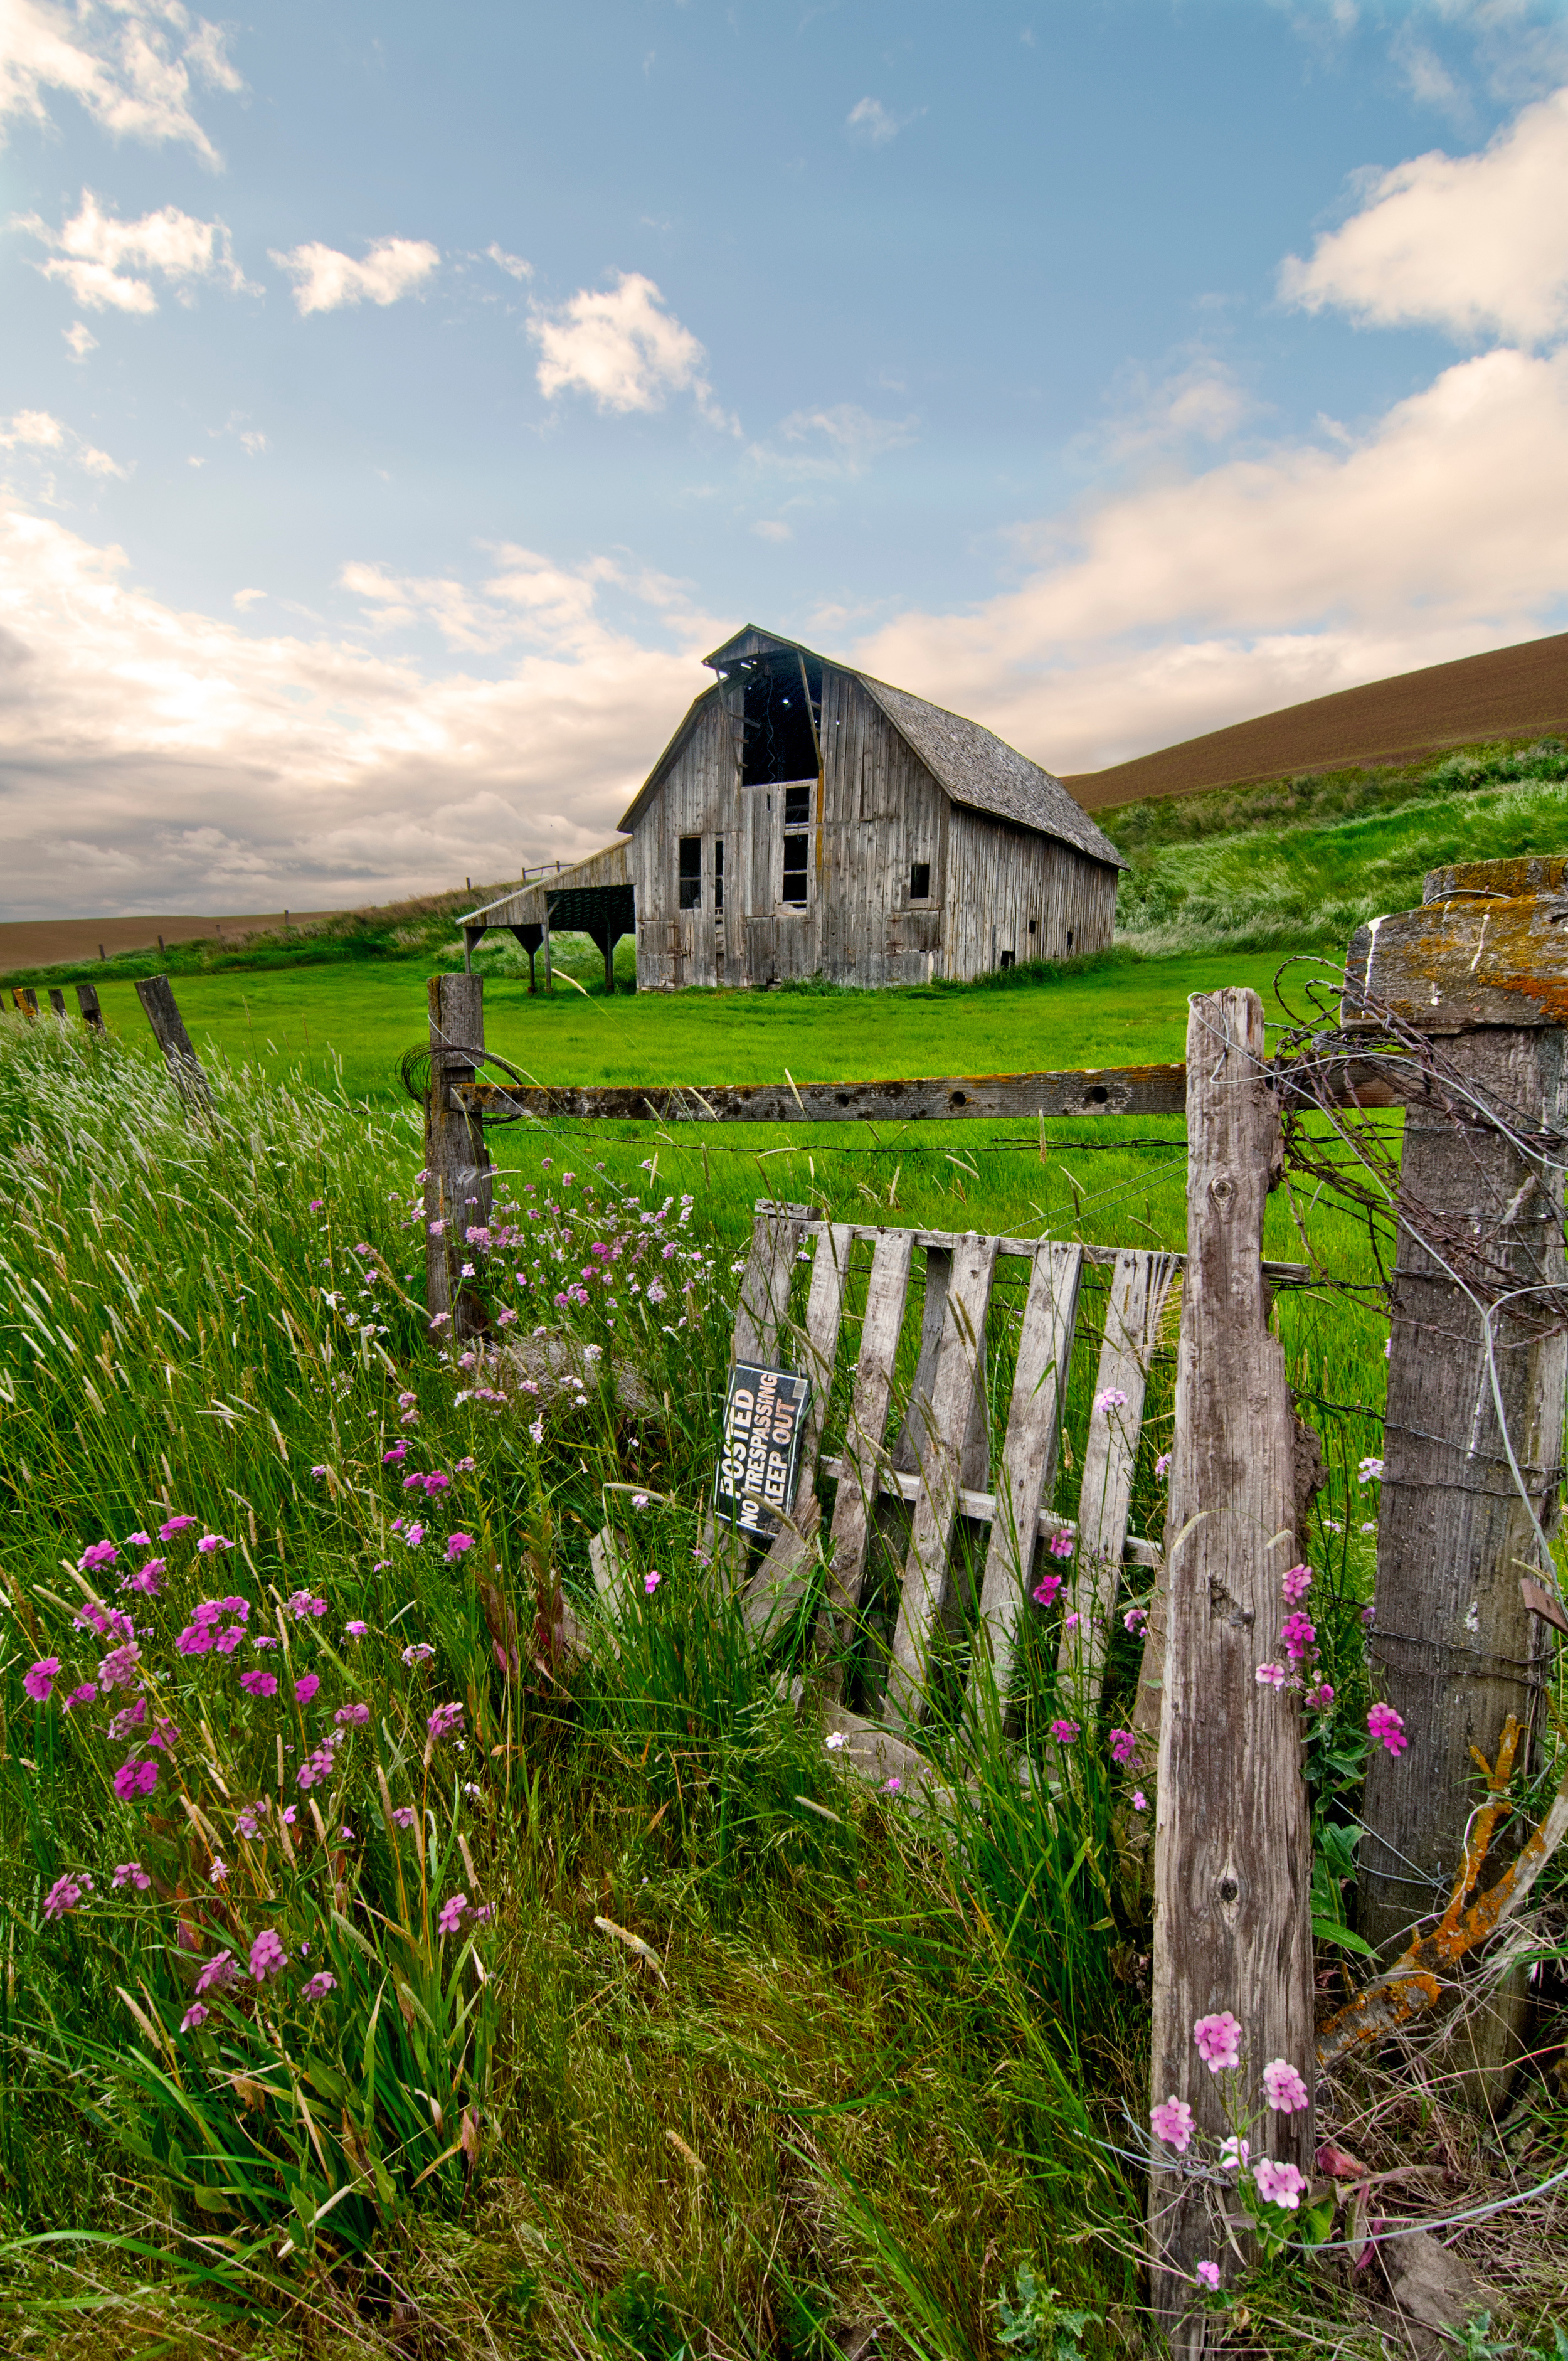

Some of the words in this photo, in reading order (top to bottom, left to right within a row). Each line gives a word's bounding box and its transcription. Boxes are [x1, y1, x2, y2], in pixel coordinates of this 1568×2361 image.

[719, 1389, 755, 1500] POSTED
[745, 1374, 778, 1492] TRESPASSING
[772, 1398, 796, 1445] OUT
[763, 1451, 788, 1511] KEEP
[740, 1499, 760, 1527] NO
